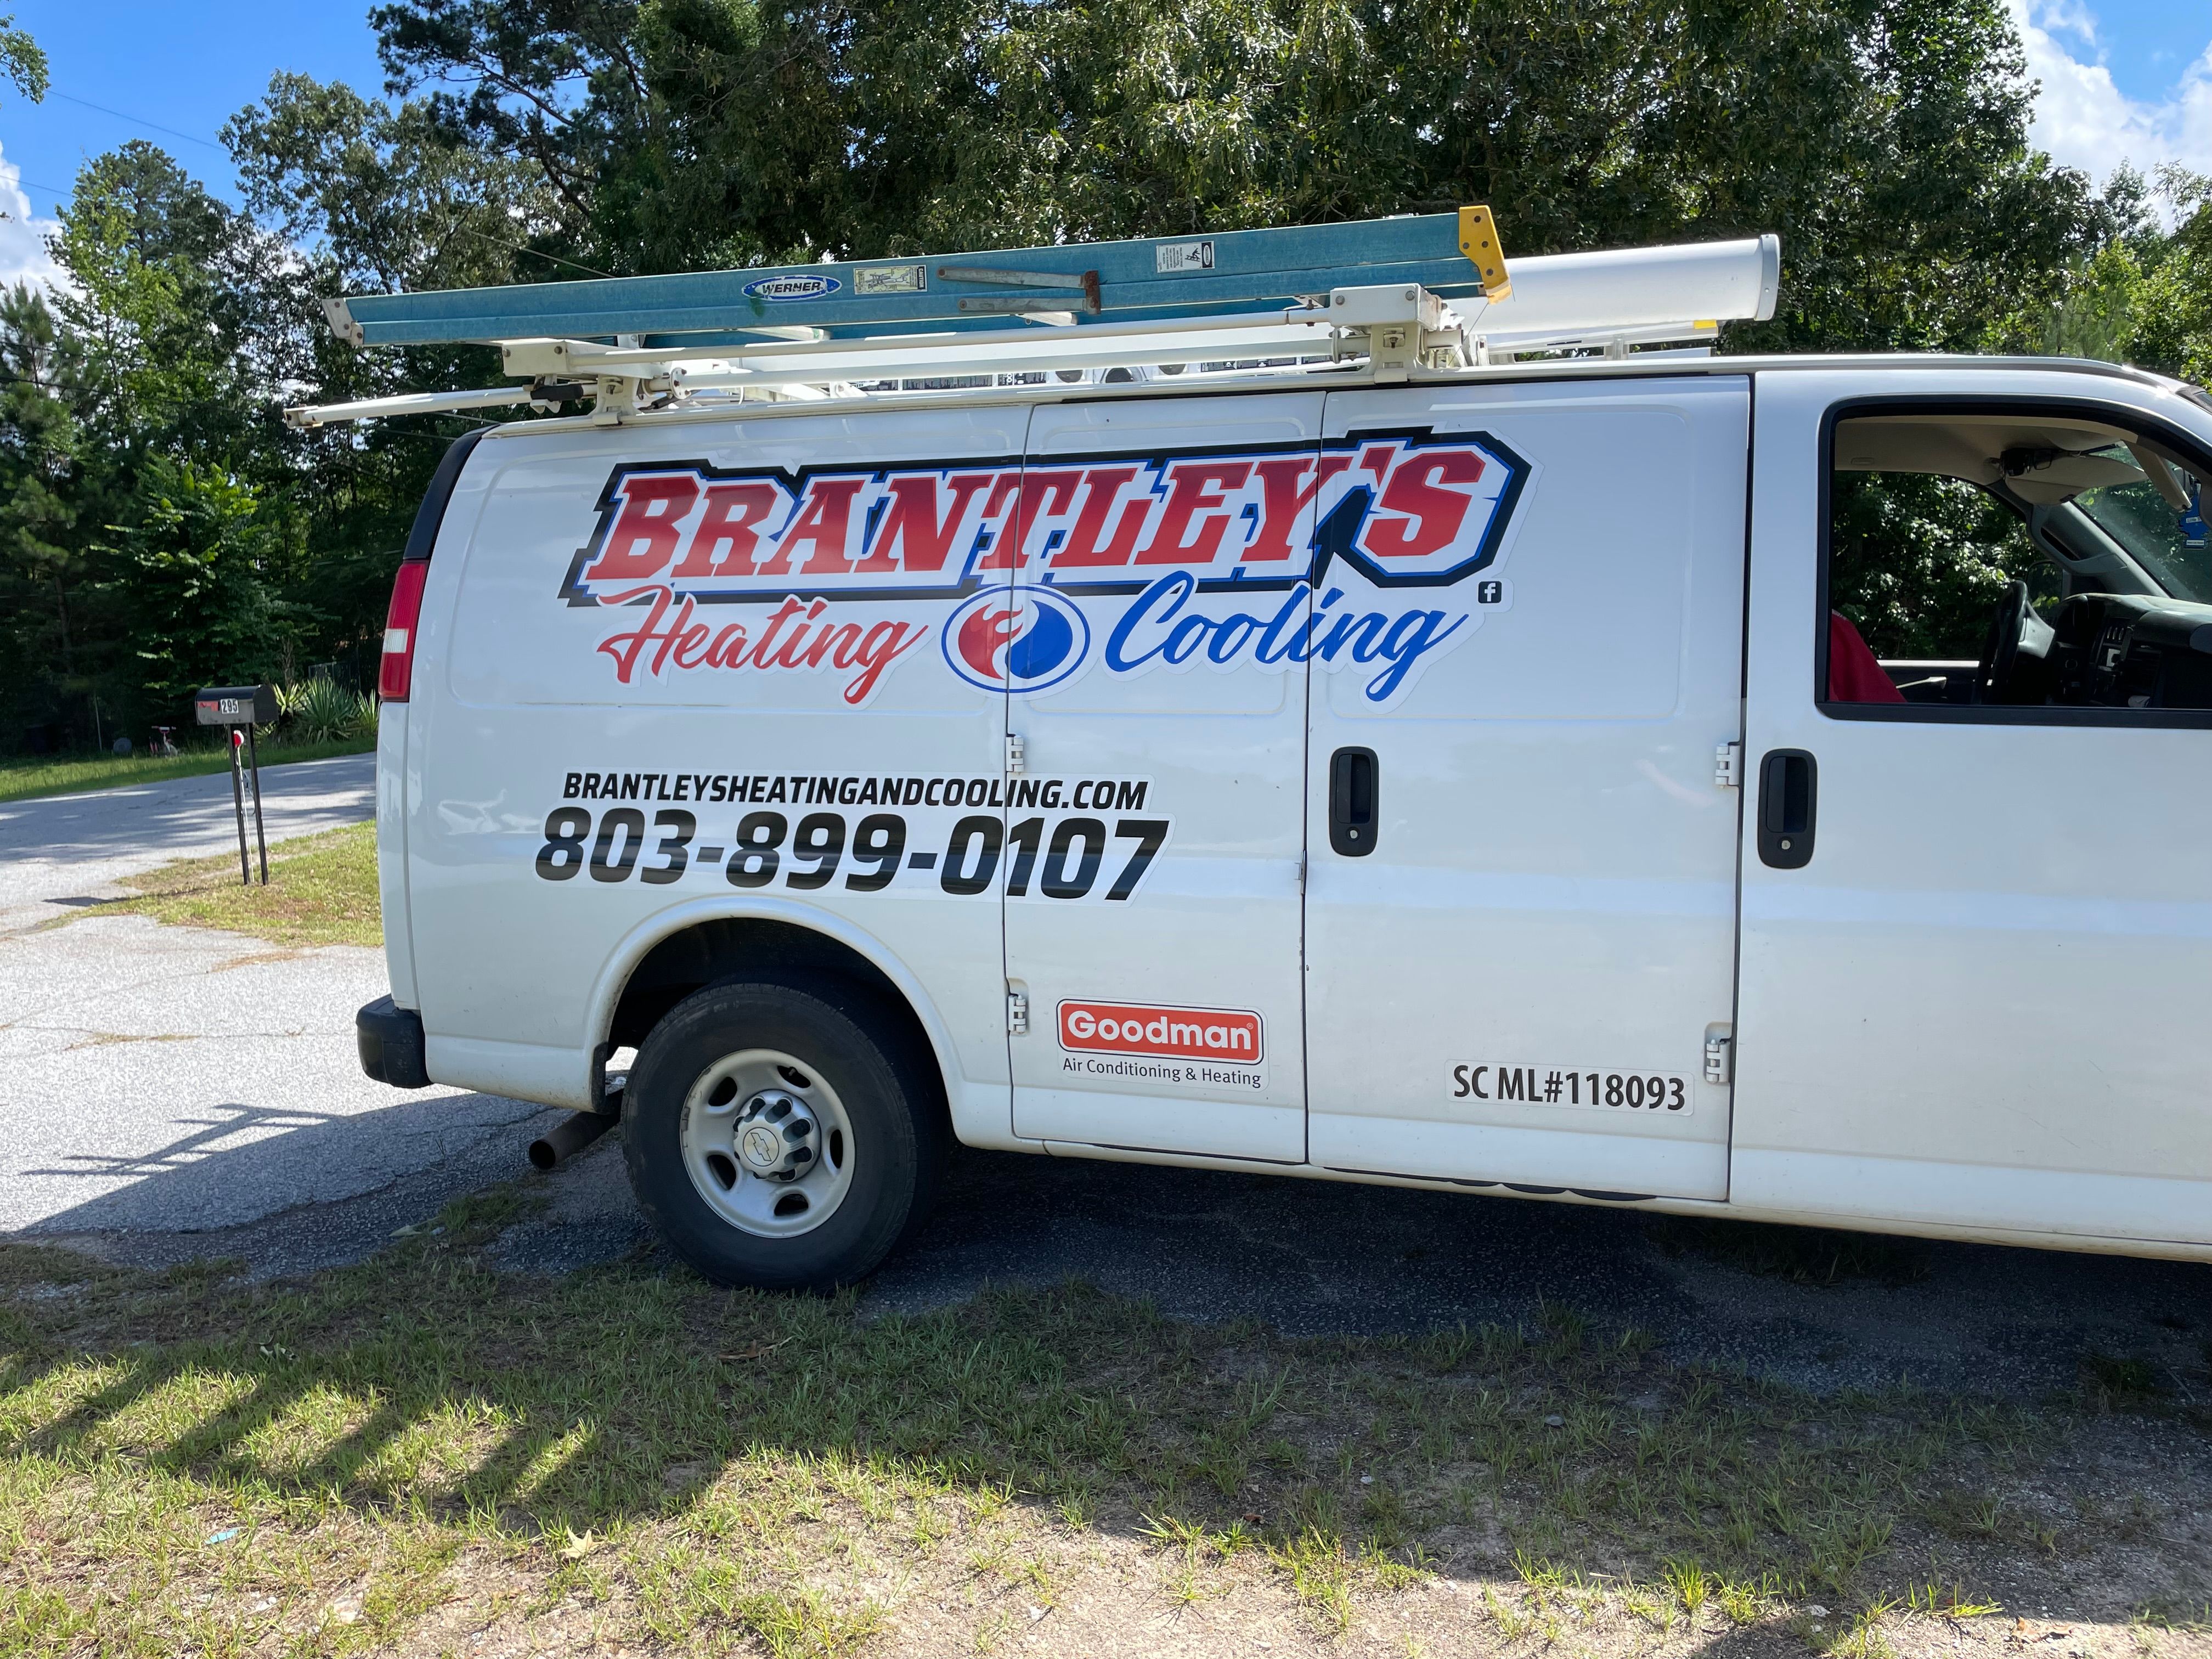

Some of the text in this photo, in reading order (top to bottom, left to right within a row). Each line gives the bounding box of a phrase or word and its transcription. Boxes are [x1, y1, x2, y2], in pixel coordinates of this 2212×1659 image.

[763, 282, 821, 294] WERNER
[586, 447, 1486, 580] BRANTLEY'S
[596, 571, 1469, 704] Heating Cooling
[563, 772, 1148, 810] BRANTLEYSHEATINGANDCOOLING.COM
[534, 806, 1170, 900] 803-899-0107
[1063, 1058, 1261, 1088] Air Conditioning & Heating
[1454, 1065, 1685, 1111] SC ML#118093
